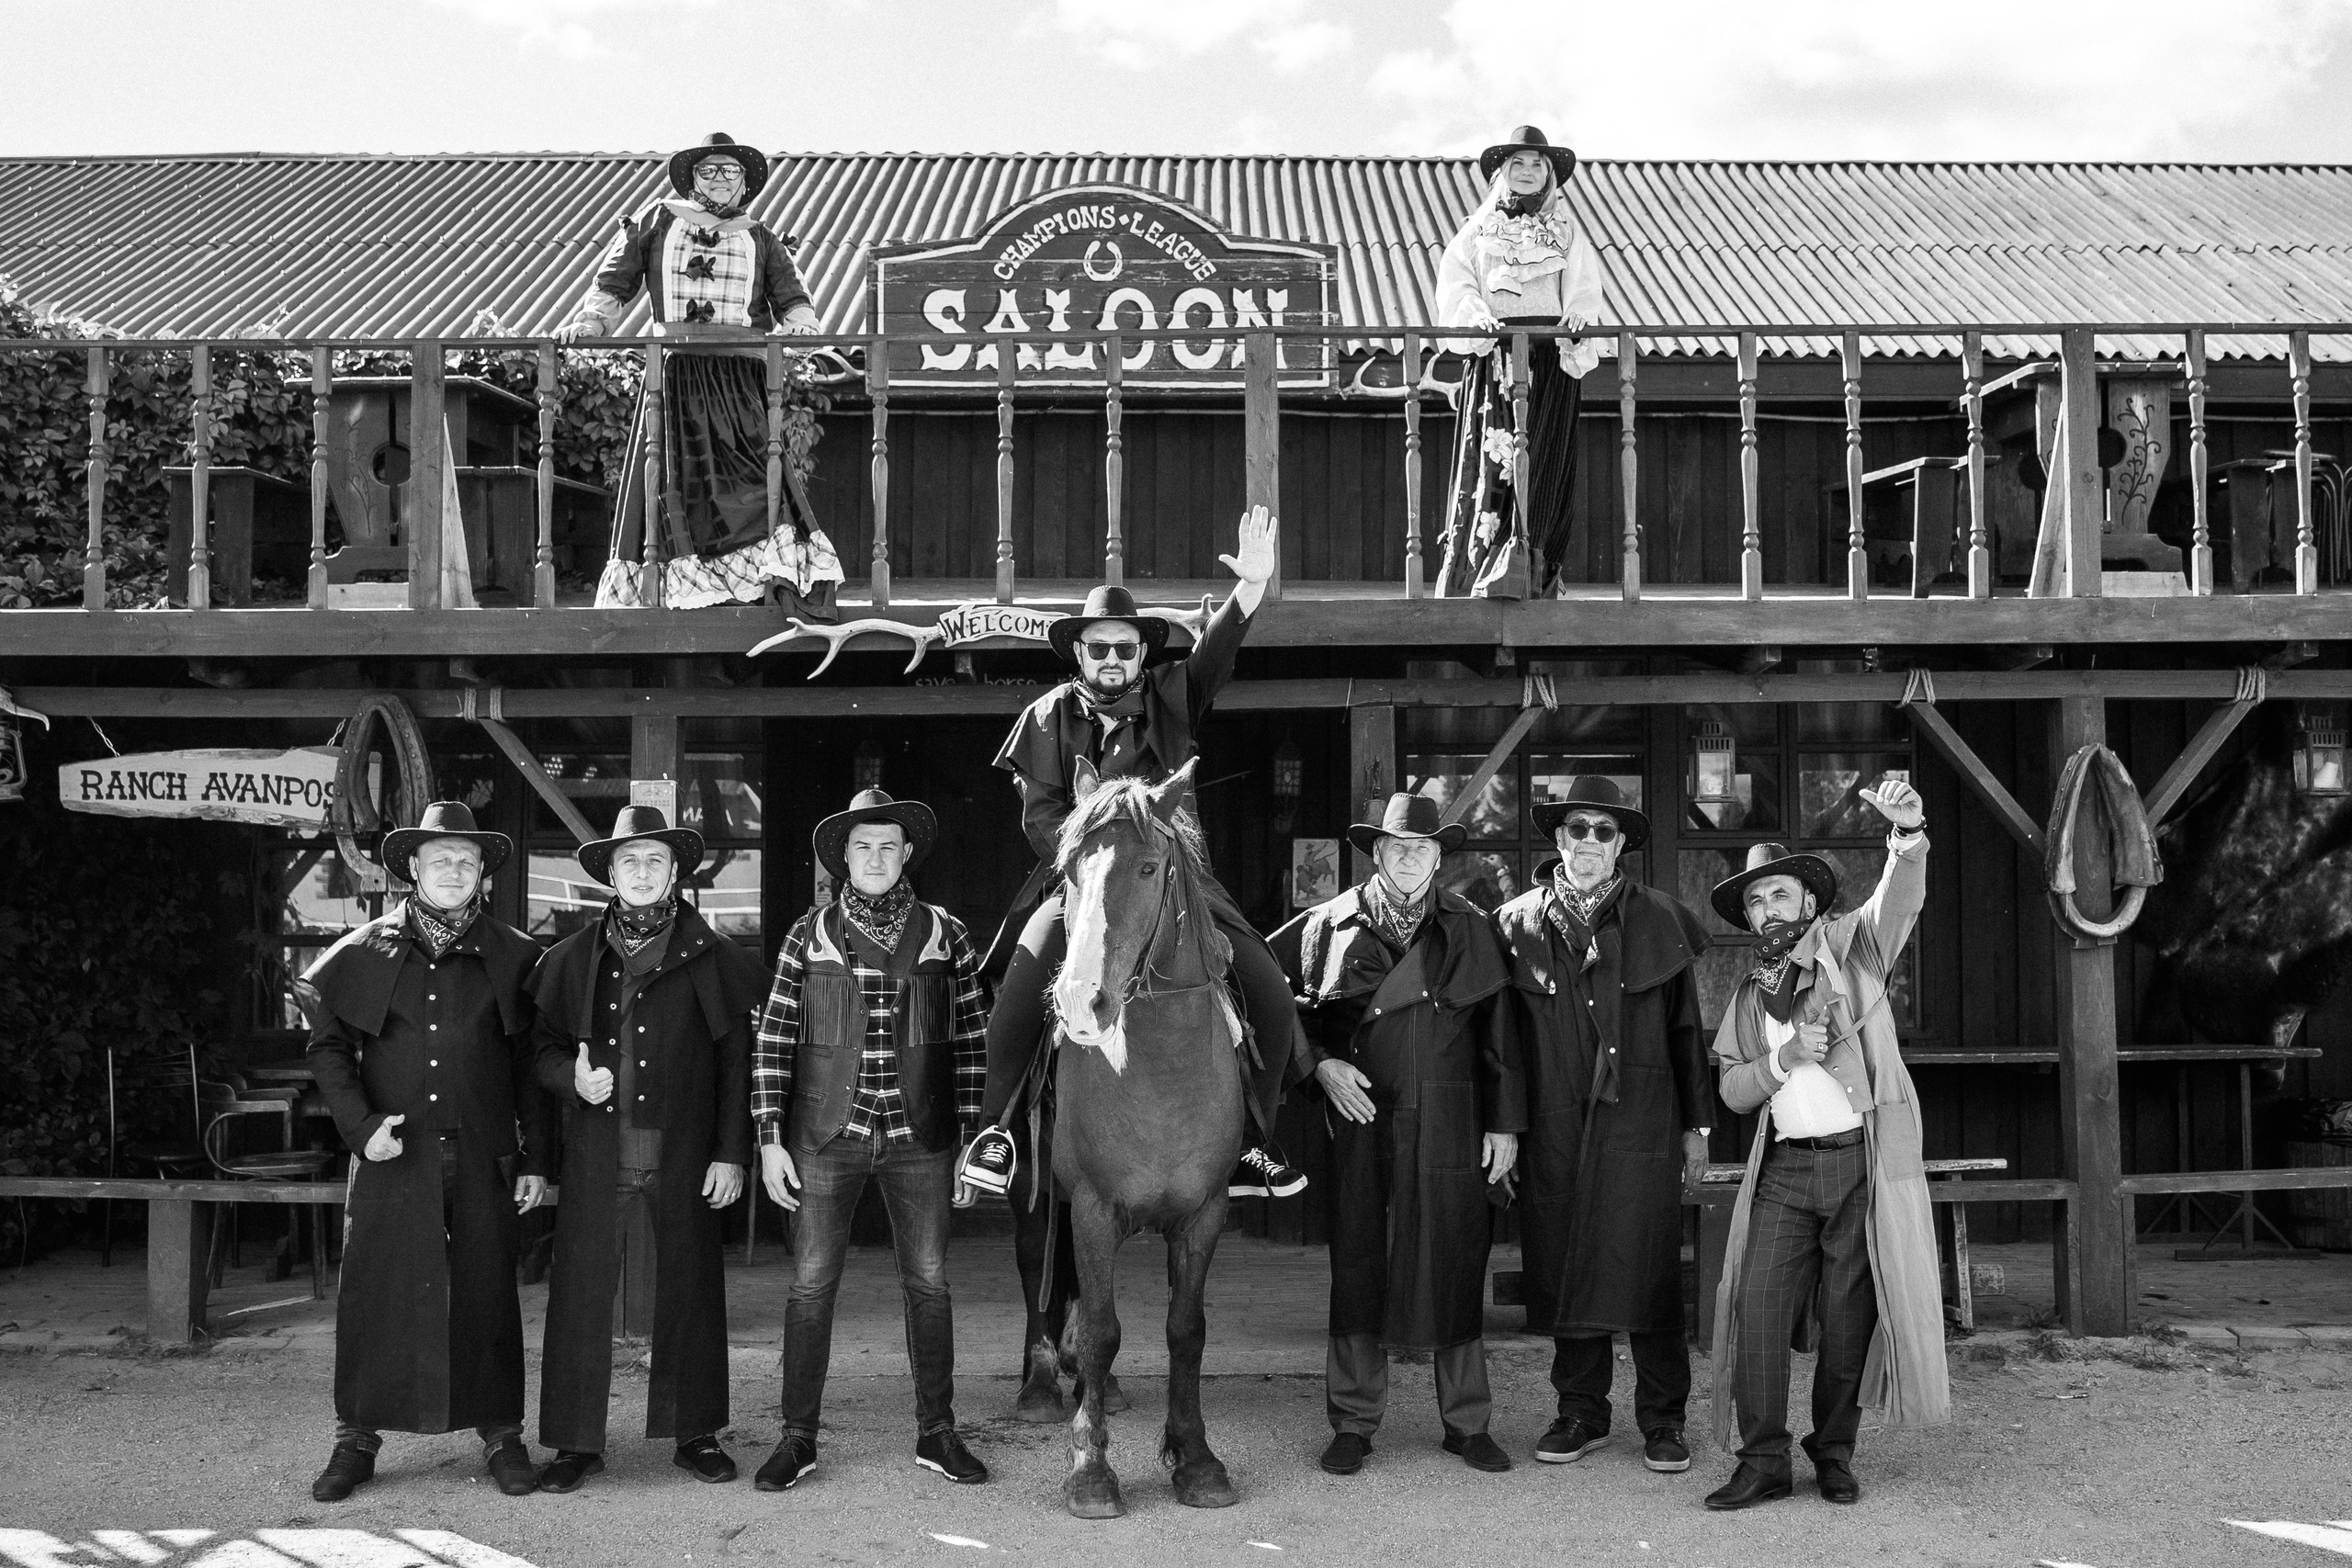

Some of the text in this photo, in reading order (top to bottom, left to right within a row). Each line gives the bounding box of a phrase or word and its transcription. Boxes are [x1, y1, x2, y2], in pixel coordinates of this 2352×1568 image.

[992, 206, 1216, 281] CHAMPIONS LEAGUE
[921, 287, 1288, 370] SALOON
[944, 611, 1051, 642] WELCOM
[80, 770, 334, 809] RANCH AVANPOS
